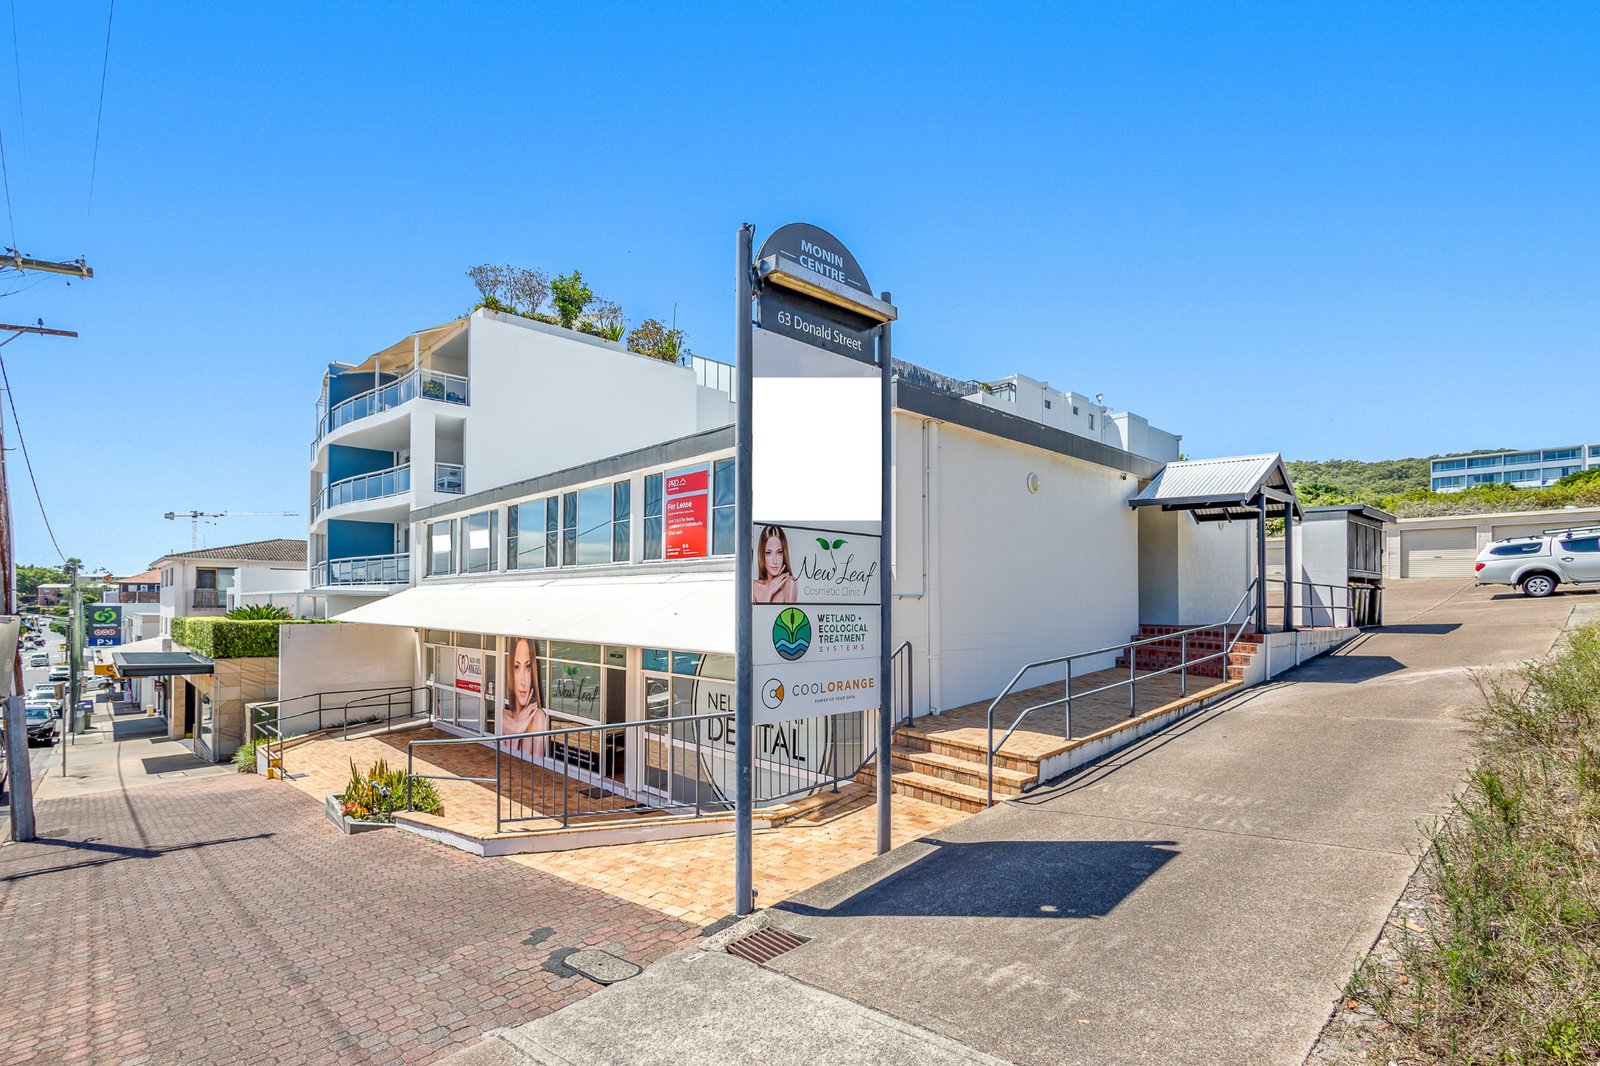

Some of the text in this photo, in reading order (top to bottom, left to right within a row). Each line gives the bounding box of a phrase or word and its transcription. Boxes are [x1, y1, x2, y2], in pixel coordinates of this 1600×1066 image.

[801, 239, 843, 268] MONIN
[799, 255, 846, 284] CENTRE
[777, 311, 862, 351] 63 Donald Street
[668, 501, 692, 511] For Lease
[793, 552, 878, 597] New Leaf
[803, 585, 861, 597] Cosmetic Clinic
[817, 613, 856, 623] WETLAND
[818, 623, 868, 633] ECOLOGICAL
[818, 633, 865, 643] TREATMENT
[819, 644, 865, 652] SYSTEMS
[553, 678, 599, 714] New Leaf
